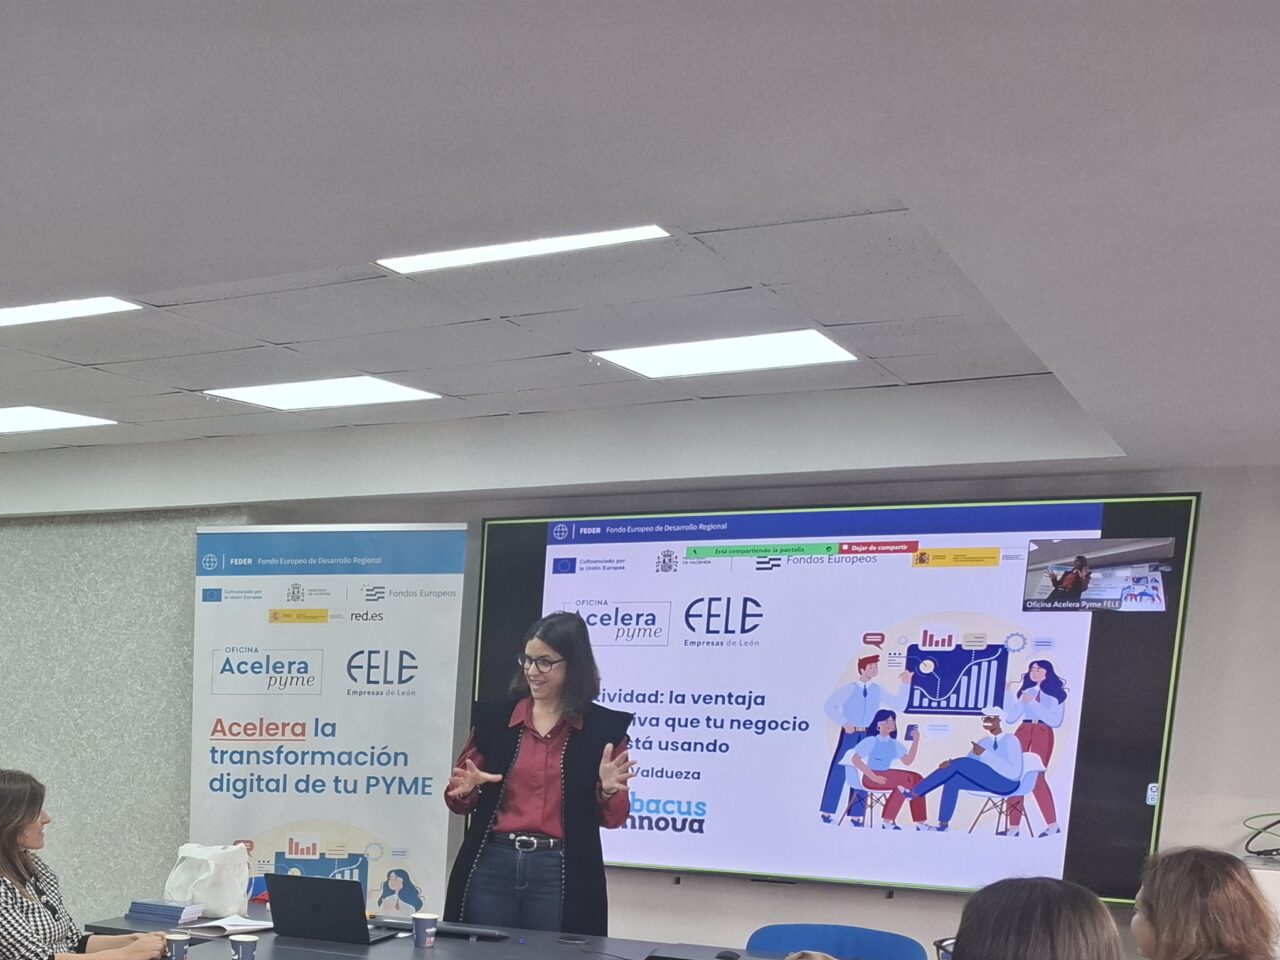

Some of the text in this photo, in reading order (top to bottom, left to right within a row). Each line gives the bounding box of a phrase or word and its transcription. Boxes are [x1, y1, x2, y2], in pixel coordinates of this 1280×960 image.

[580, 522, 728, 535] FEDER Fondo Europeo de Desarrollo Regional
[729, 547, 771, 556] compartiendo
[780, 546, 805, 554] pantalla
[851, 544, 867, 552] Dejar
[258, 557, 279, 565] Fondo
[280, 557, 307, 567] Europeo
[308, 557, 317, 565] de
[318, 556, 352, 565] Desarrollo
[353, 556, 382, 566] Regional
[787, 554, 878, 566] Fondos Europeos
[388, 589, 457, 600] Fondos Europeos
[1026, 600, 1120, 610] Oficina Acelera Pyme FELE
[350, 610, 384, 622] red.es
[684, 596, 763, 634] FELE
[614, 627, 663, 642] pyme
[684, 639, 760, 648] Empresas de León
[219, 654, 309, 674] Acelera
[346, 650, 418, 685] FELE
[267, 675, 316, 691] pyme
[347, 688, 416, 697] Empresas de León
[668, 690, 686, 704] la
[691, 691, 766, 711] ventaja
[210, 717, 337, 738] Acelera la
[632, 712, 810, 735] iva que tu negocio
[627, 735, 730, 754] stá usando
[210, 744, 409, 767] transformación
[631, 767, 701, 780] Valdueza
[209, 773, 433, 799] digital de tu PYME
[630, 791, 707, 817] bacus
[622, 814, 705, 834] nnova
